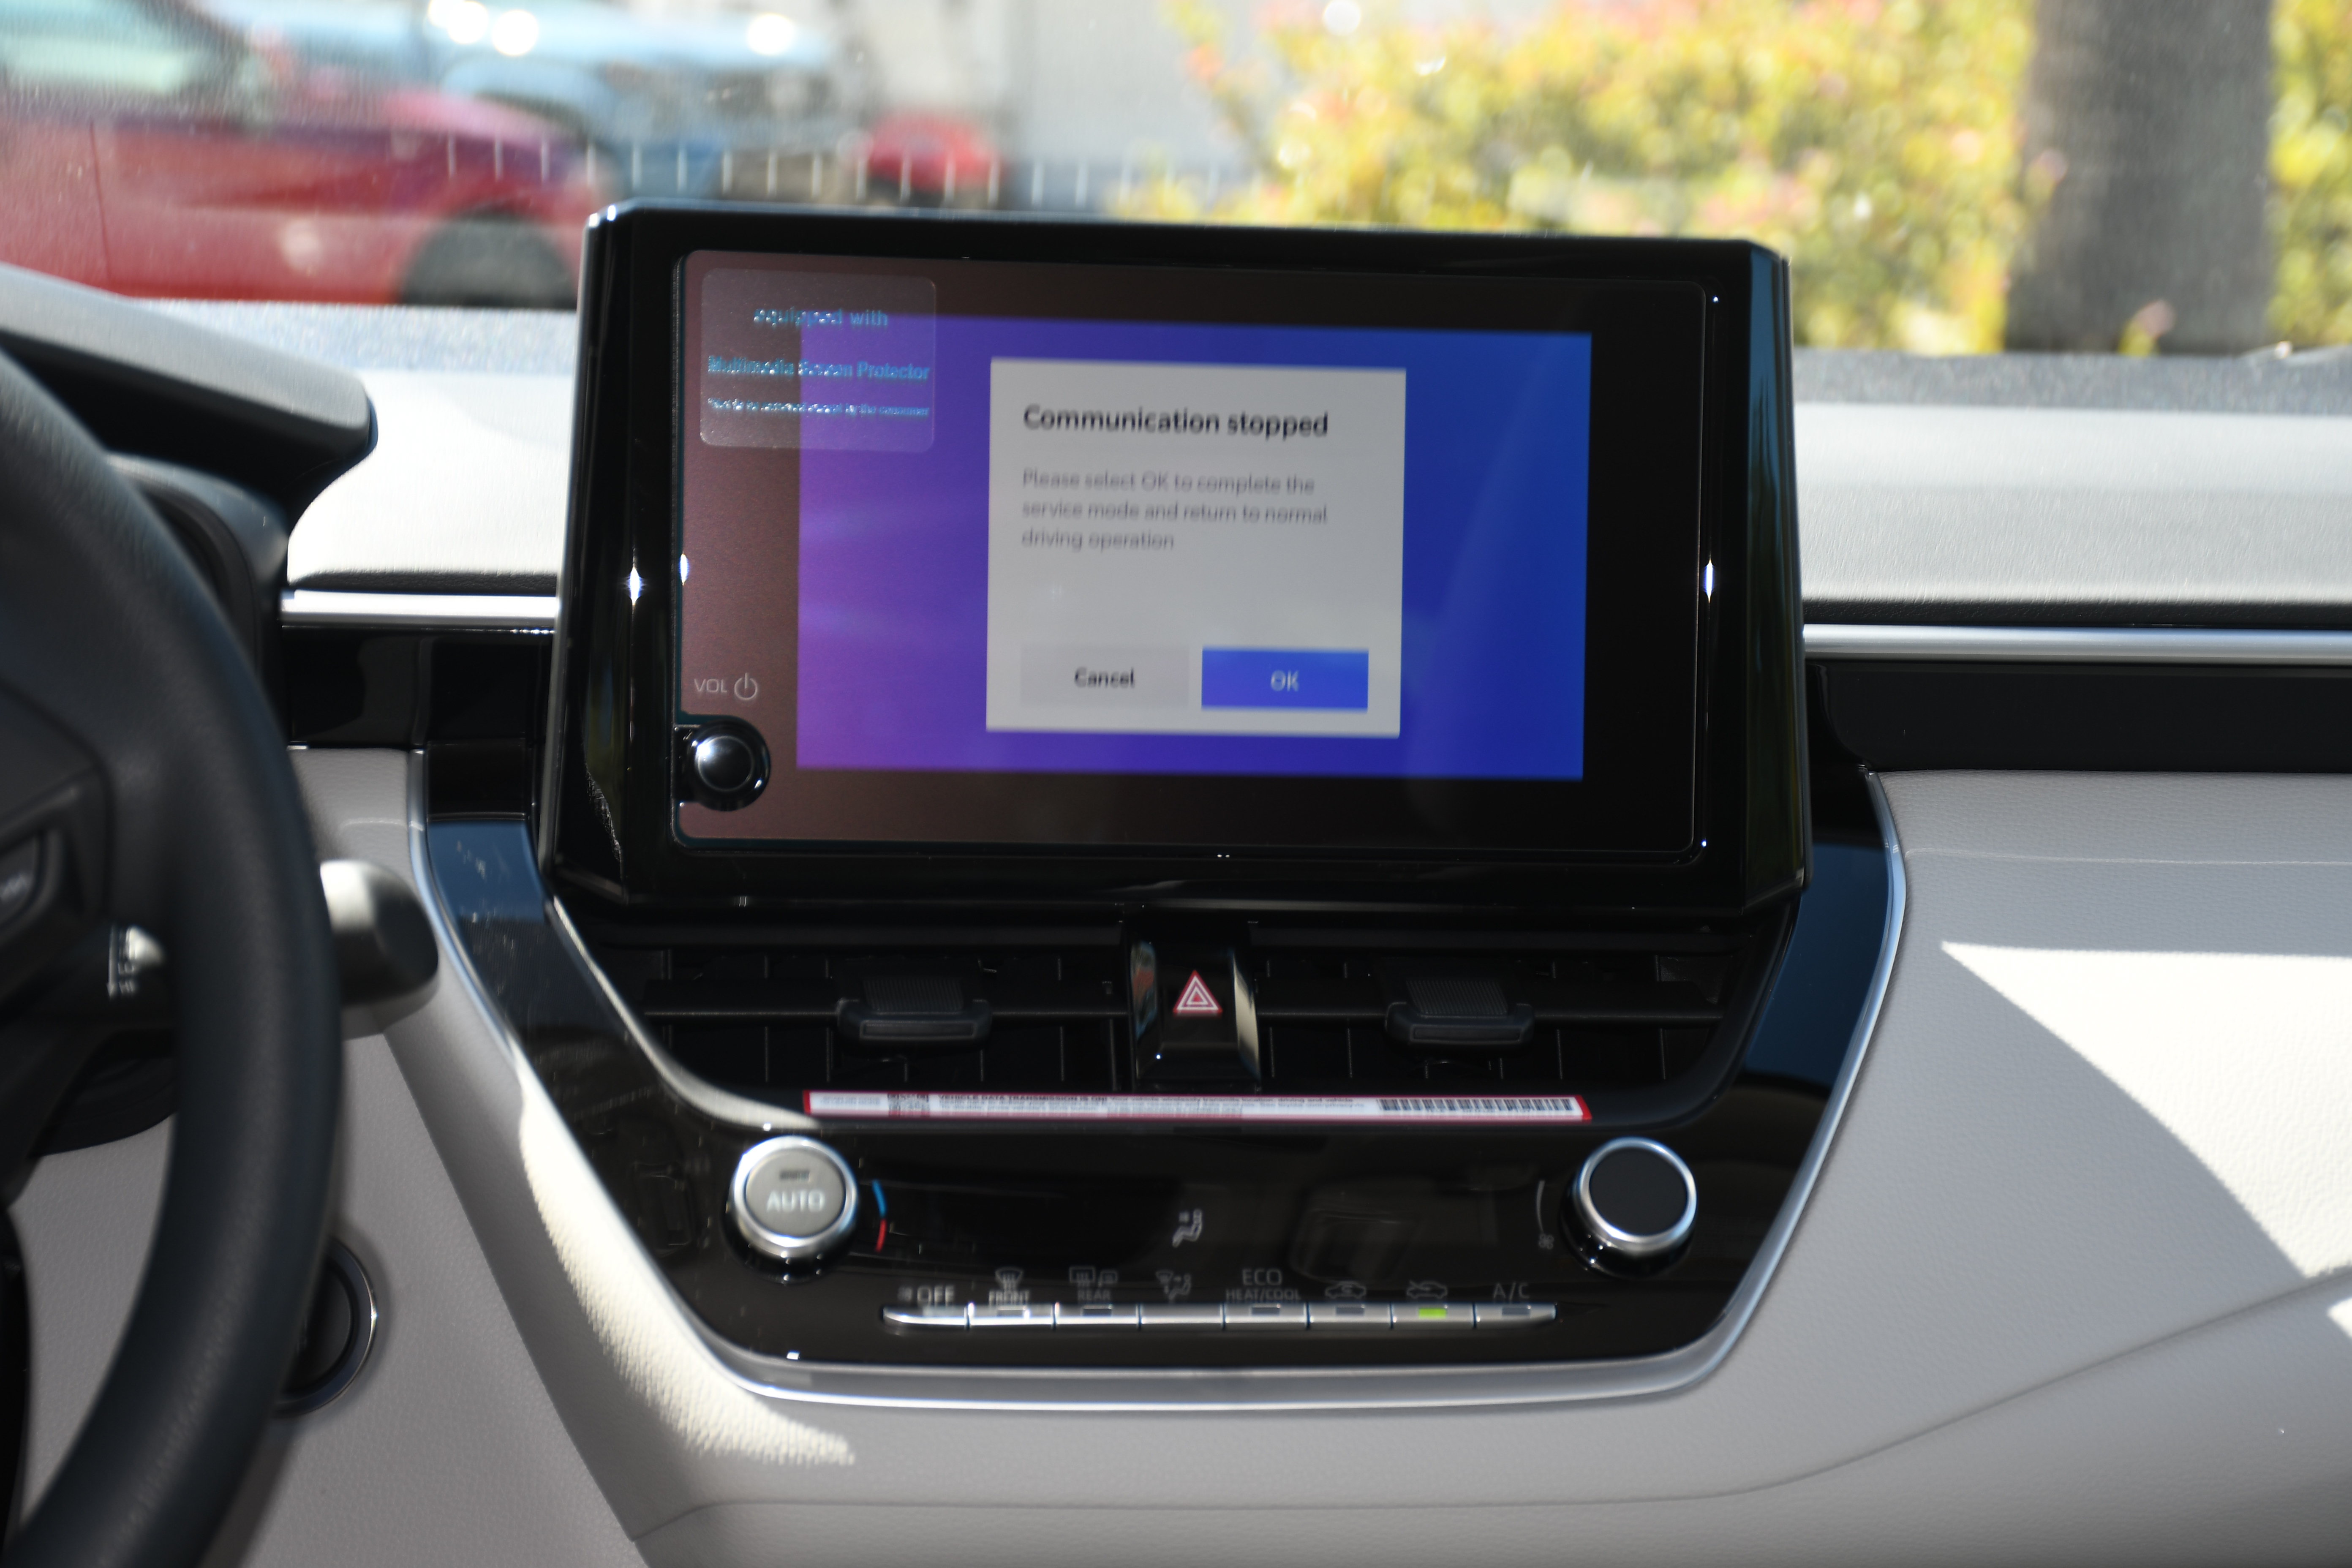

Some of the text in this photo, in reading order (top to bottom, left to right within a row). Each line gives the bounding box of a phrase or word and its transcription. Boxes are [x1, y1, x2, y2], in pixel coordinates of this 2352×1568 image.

[754, 307, 887, 327] equipped with
[798, 359, 852, 376] Screen
[857, 361, 930, 380] Protector
[1024, 403, 1328, 442] Communication stopped
[1023, 467, 1315, 498] Please select OK to complete the
[1022, 499, 1328, 525] service mode and return to normal
[1022, 527, 1174, 554] driving operation
[694, 678, 728, 693] VOL
[1074, 667, 1135, 689] Cancel
[1270, 670, 1299, 692] OK
[766, 1190, 826, 1212] AUTO
[1242, 1269, 1282, 1285] ECO
[917, 1286, 954, 1304] OFF
[988, 1290, 1029, 1304] FRONT
[1078, 1290, 1111, 1301] REAR
[1225, 1288, 1301, 1301] HEAT/COOL
[1493, 1282, 1530, 1300] A/C
